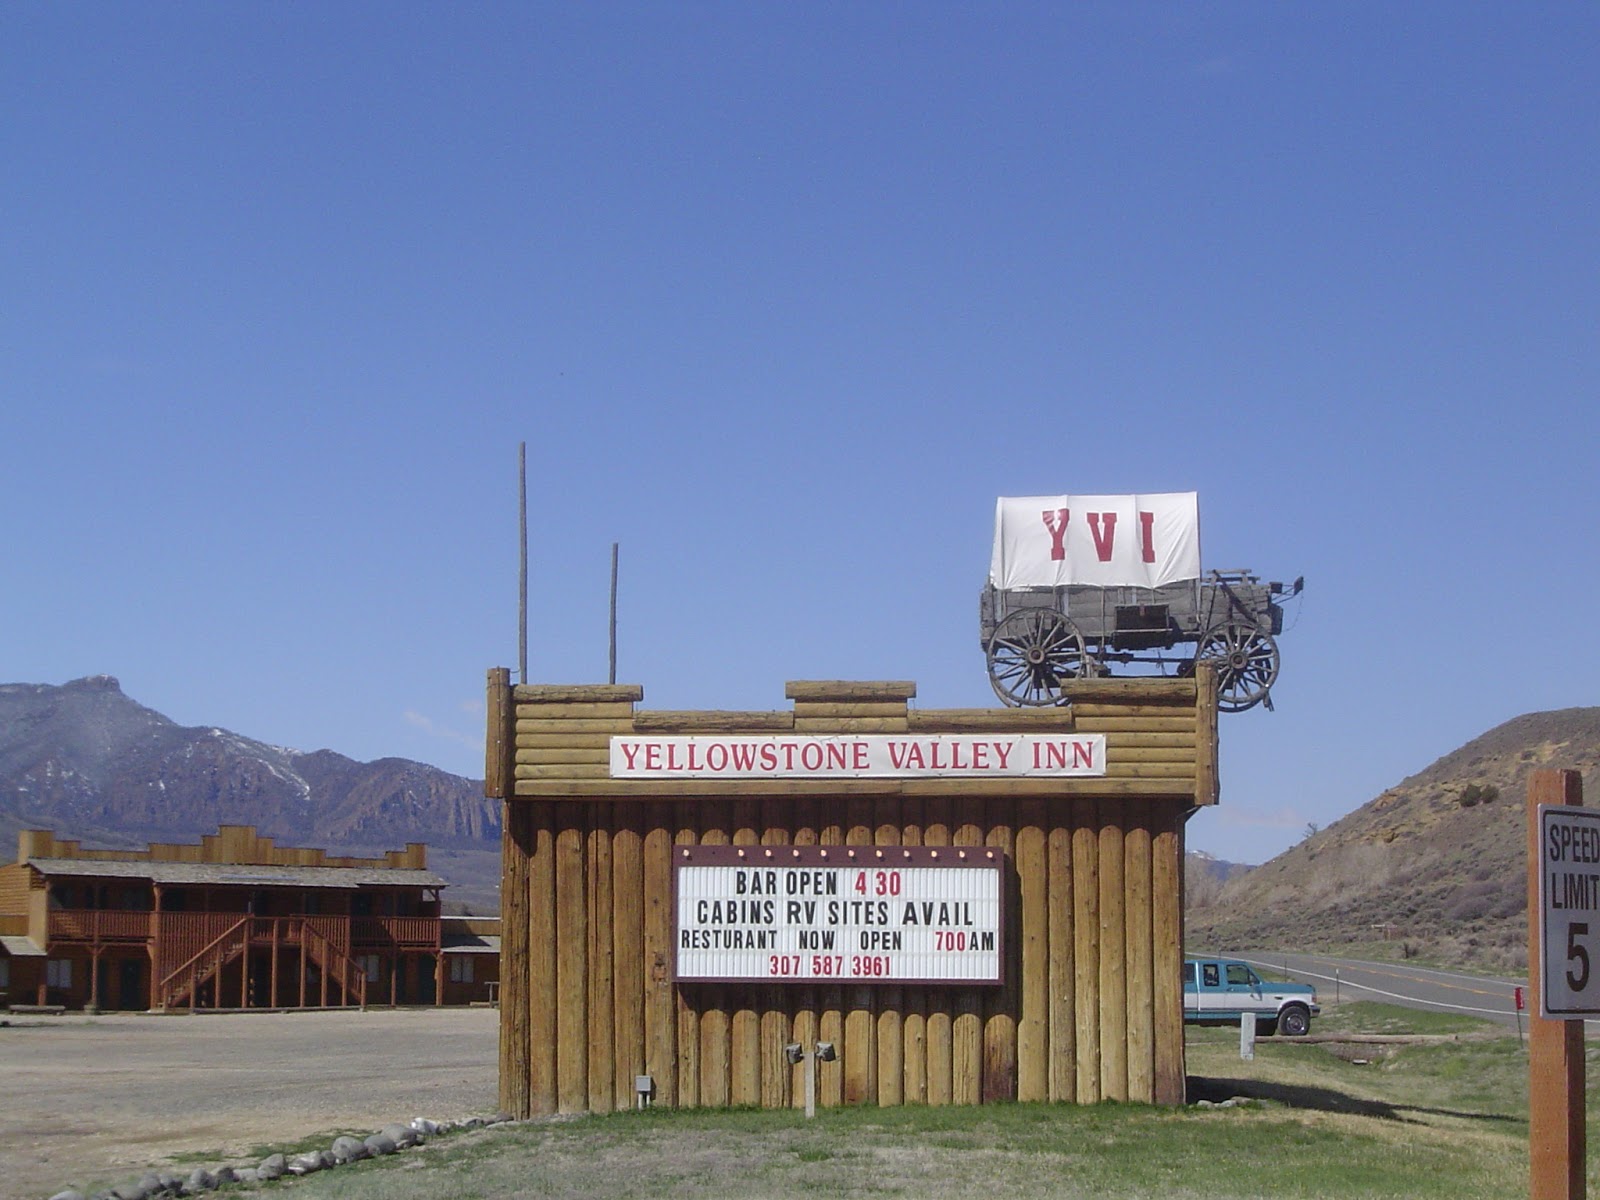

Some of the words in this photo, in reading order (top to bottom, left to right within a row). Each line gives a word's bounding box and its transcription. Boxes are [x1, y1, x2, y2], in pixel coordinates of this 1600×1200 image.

[620, 742, 871, 771] YELLOWSTONE
[889, 741, 1014, 770] VALLEY
[1032, 741, 1095, 769] INN
[1550, 824, 1600, 863] SPEED
[736, 871, 777, 895] BAR
[786, 871, 837, 895] OPEN
[1551, 872, 1600, 910] LIMIT
[697, 899, 775, 925] CABINS
[786, 900, 817, 925] RV
[828, 901, 889, 925] SITES
[902, 901, 974, 926] AVAIL
[681, 929, 778, 949] RESTURANT
[799, 930, 835, 950] NOW
[860, 930, 902, 951] OPEN
[769, 955, 801, 976] 307
[812, 955, 843, 976] 587
[852, 956, 891, 977] 3961
